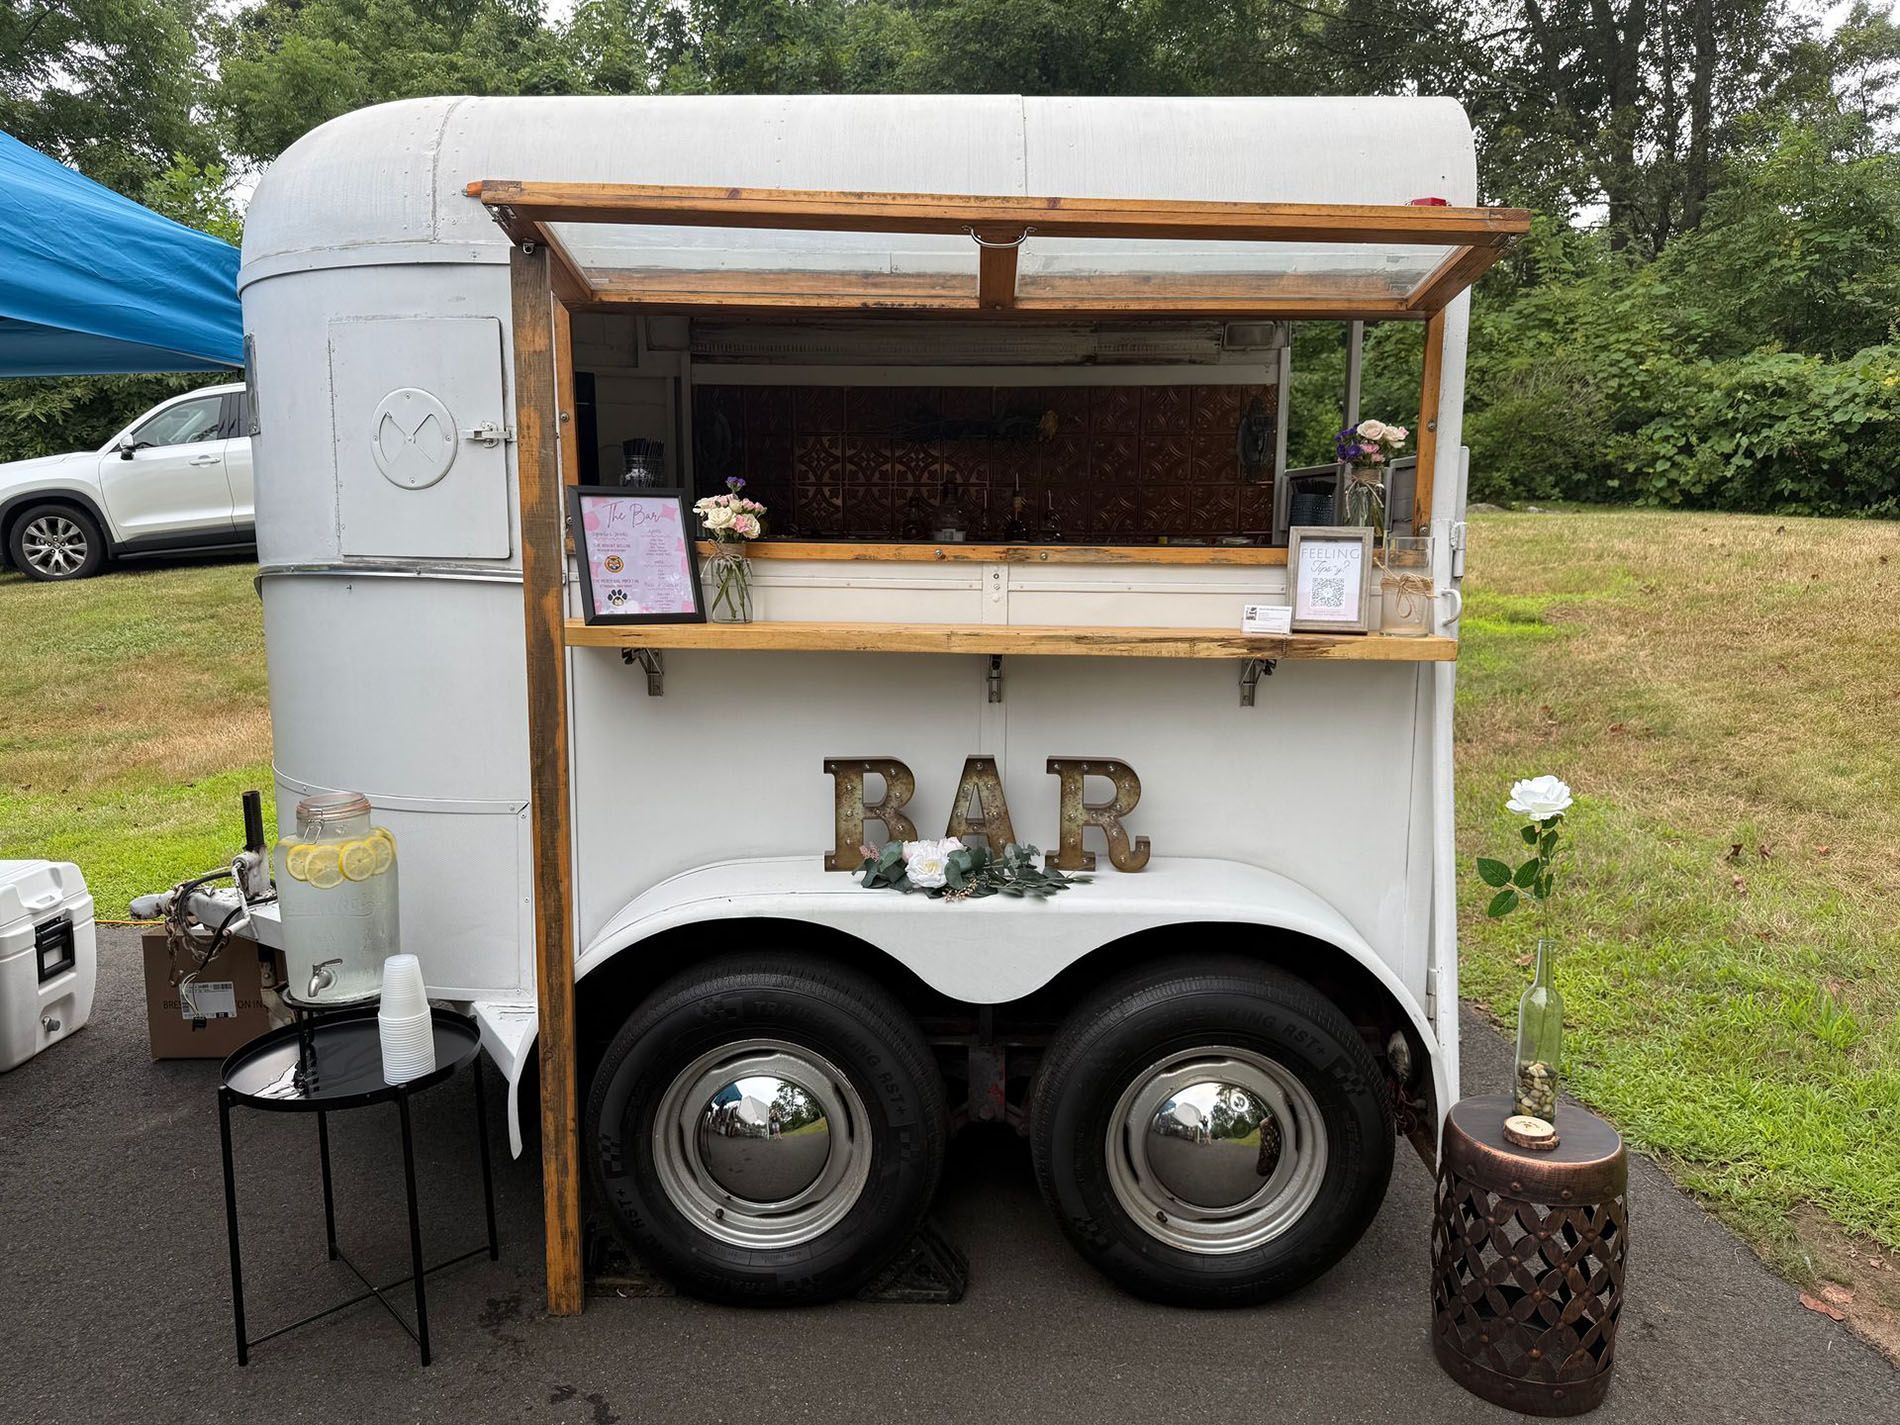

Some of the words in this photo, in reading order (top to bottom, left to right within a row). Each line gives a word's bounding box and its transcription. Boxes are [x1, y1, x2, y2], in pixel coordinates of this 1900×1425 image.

[602, 501, 625, 528] The
[630, 503, 661, 528] Bar
[1301, 548, 1360, 559] FEELING
[824, 754, 1151, 873] BAR
